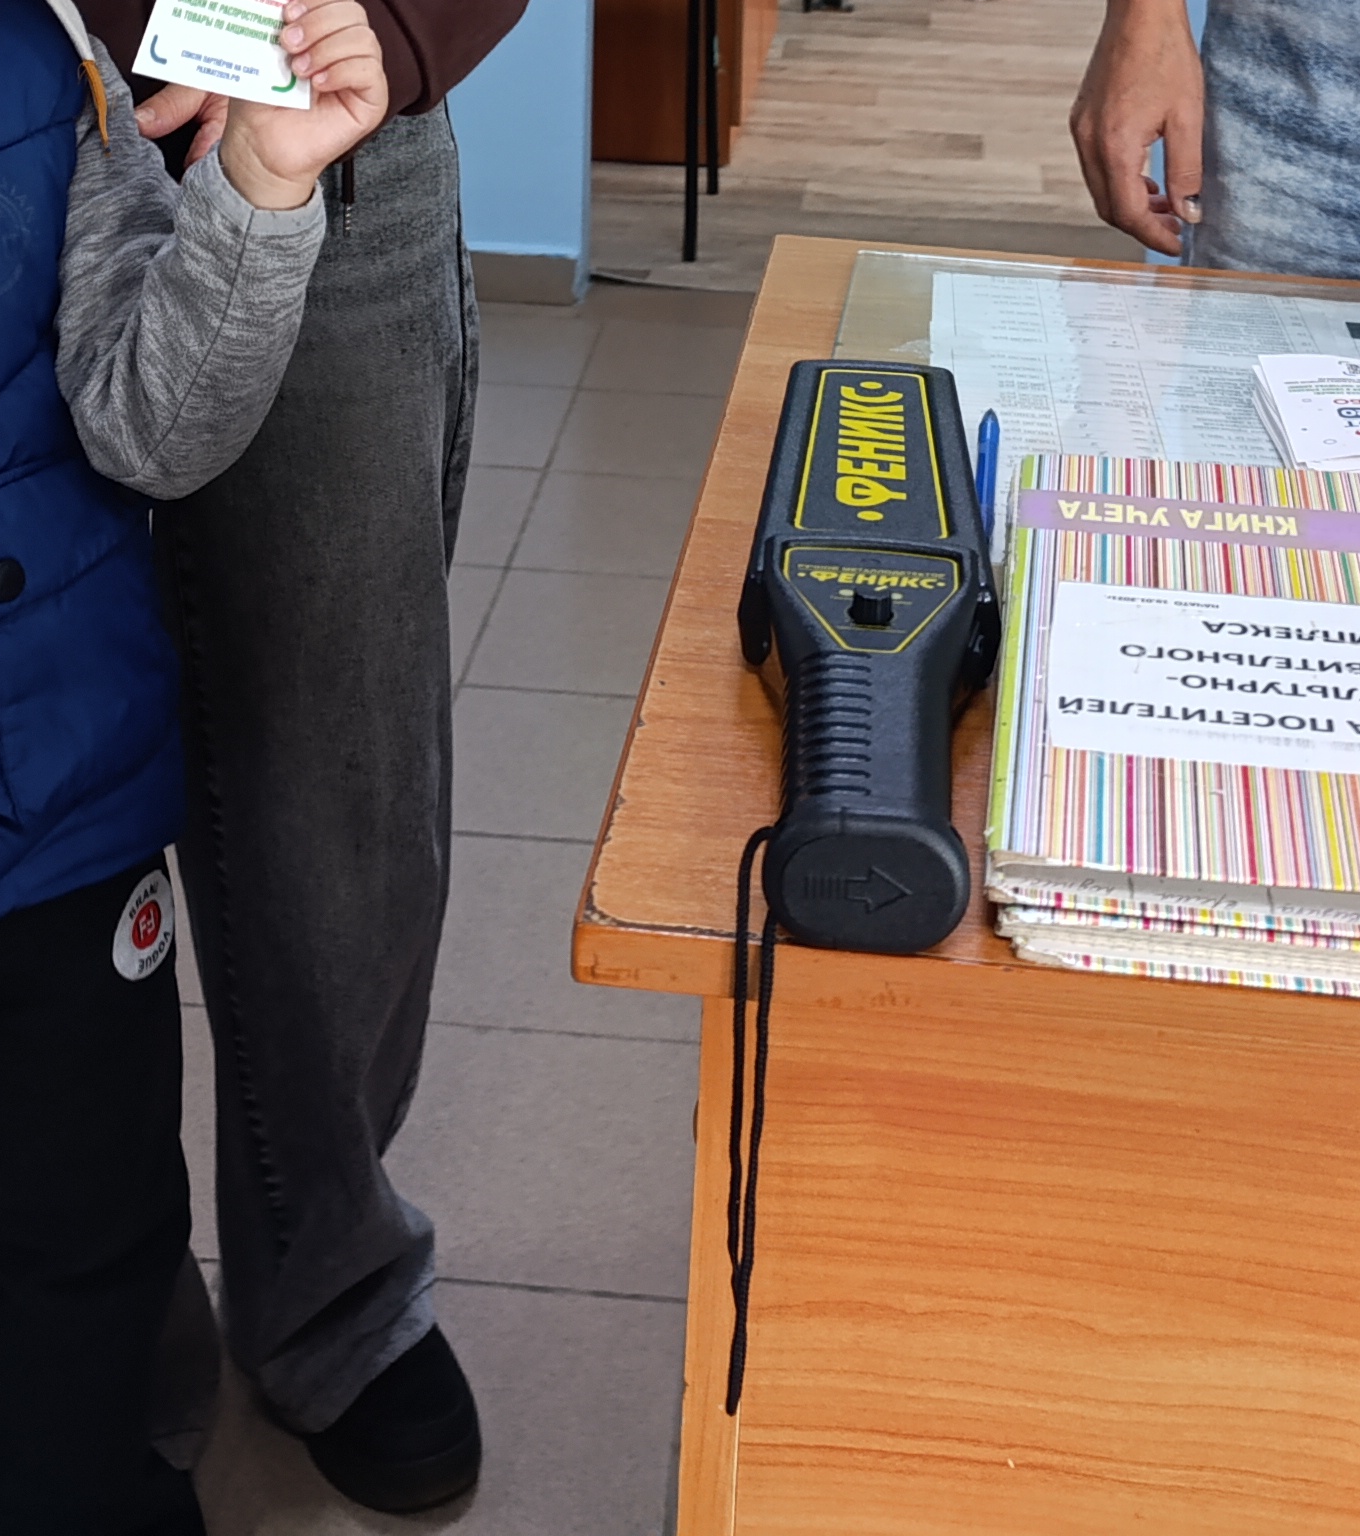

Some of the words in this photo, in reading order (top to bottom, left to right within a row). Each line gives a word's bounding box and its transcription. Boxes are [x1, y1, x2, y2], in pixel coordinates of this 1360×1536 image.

[171, 7, 182, 17] НА
[183, 11, 213, 26] ТОВАРЫ
[207, 0, 218, 11] НЕ
[835, 384, 907, 507] ФЕНИКС
[1056, 498, 1170, 529] УЧЕТА
[1180, 507, 1299, 538] КНИГА
[810, 570, 938, 590] ФЕНИКС
[1056, 695, 1335, 735] ПОСЕТИТЕЛЕЙ
